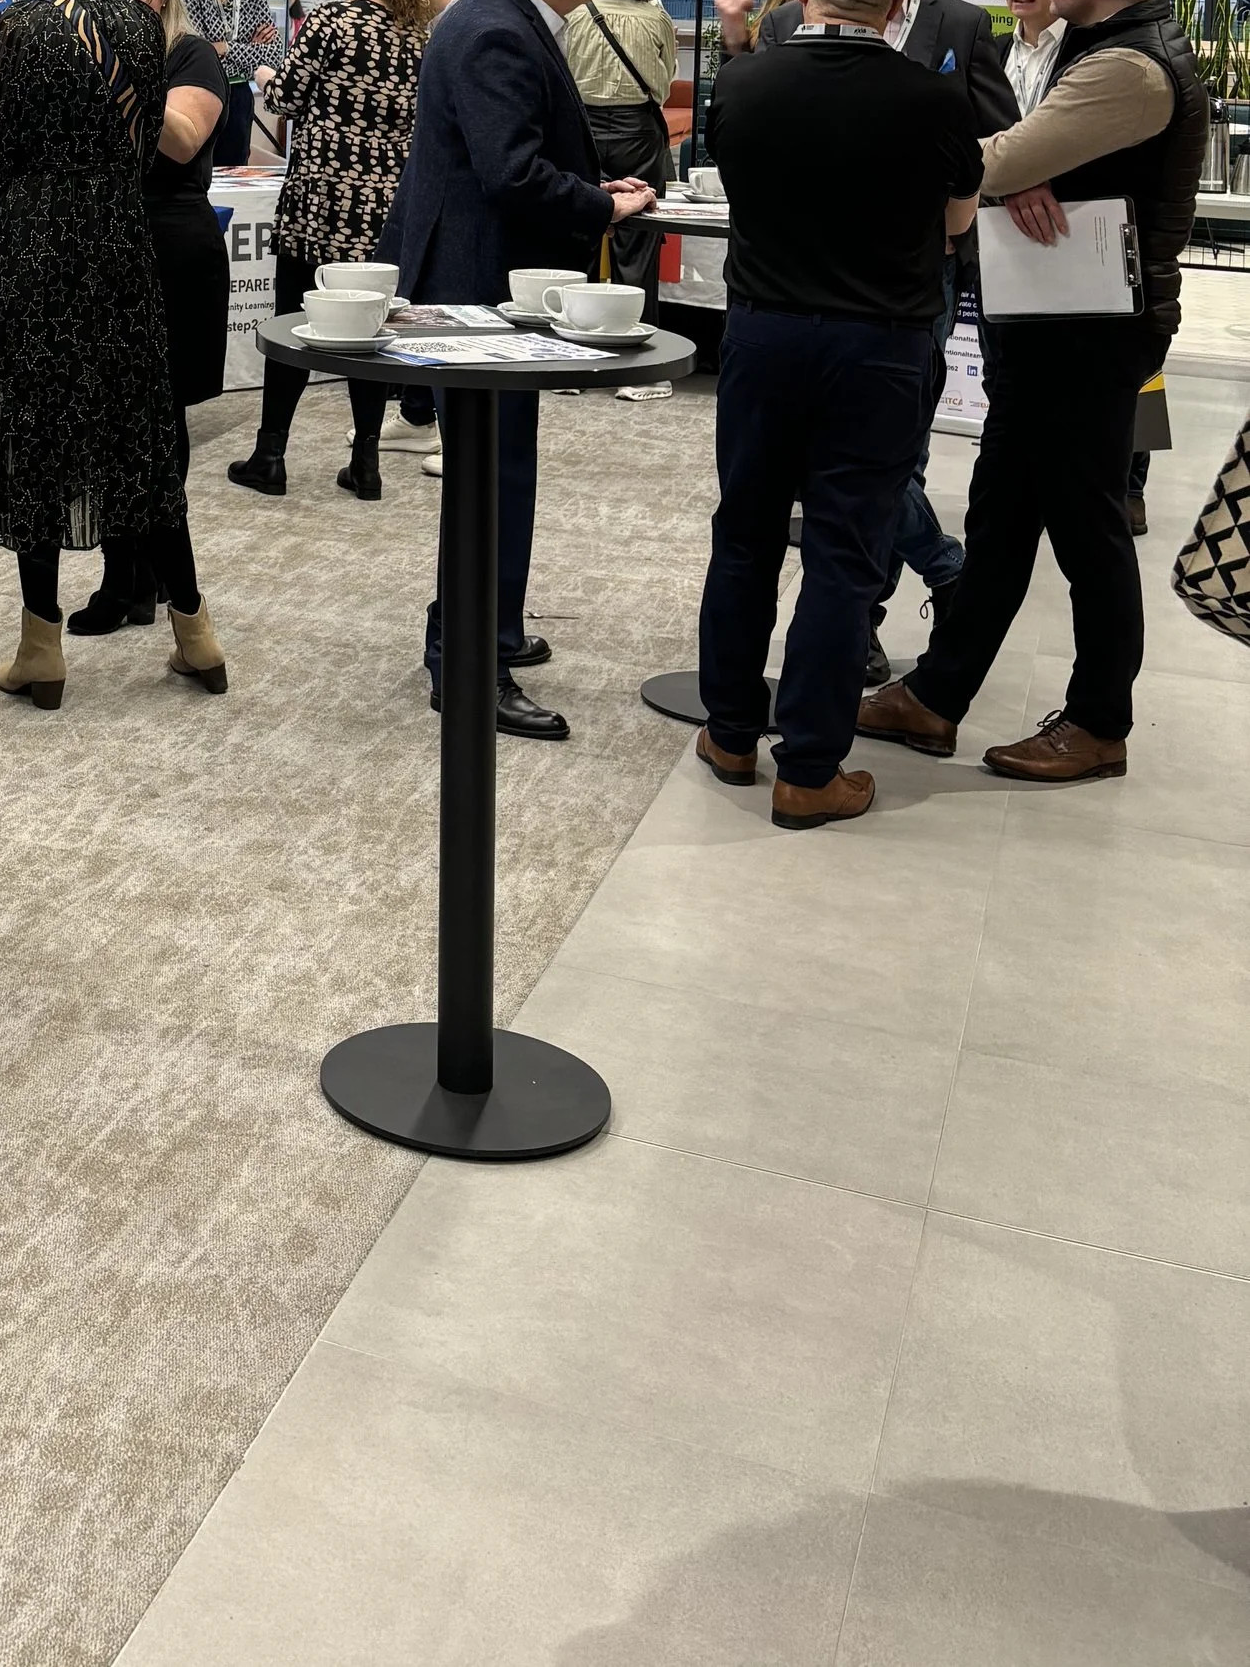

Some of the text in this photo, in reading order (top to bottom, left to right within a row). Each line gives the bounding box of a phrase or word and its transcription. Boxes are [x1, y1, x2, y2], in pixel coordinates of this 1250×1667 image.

[231, 222, 274, 262] EP
[230, 278, 270, 293] EPARE
[244, 300, 275, 311] Learning
[227, 319, 259, 334] step2
